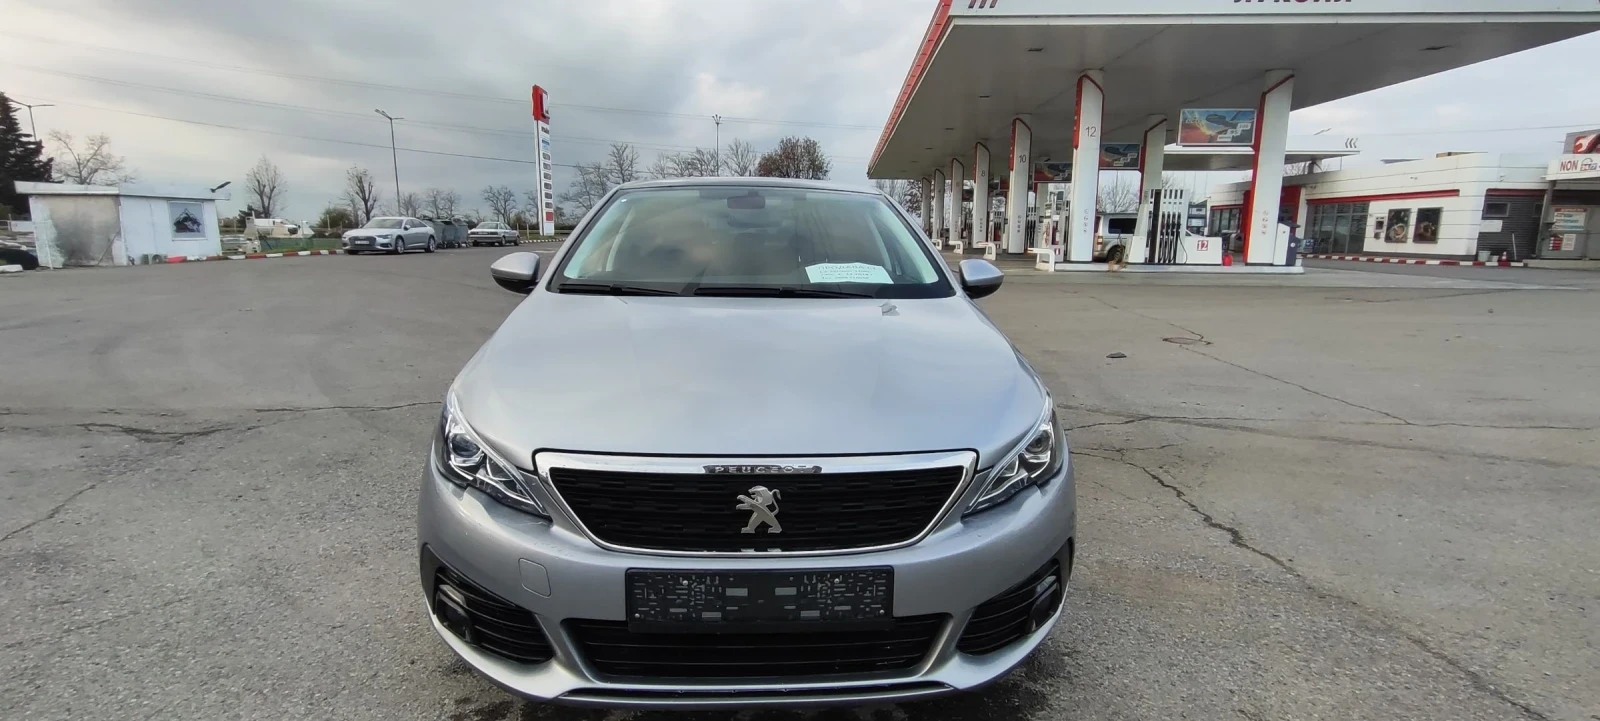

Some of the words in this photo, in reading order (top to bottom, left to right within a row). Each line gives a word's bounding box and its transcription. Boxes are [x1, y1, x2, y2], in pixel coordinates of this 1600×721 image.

[1085, 126, 1097, 138] 12
[1018, 154, 1027, 164] 10
[1560, 160, 1578, 171] NON
[1198, 240, 1208, 250] 12
